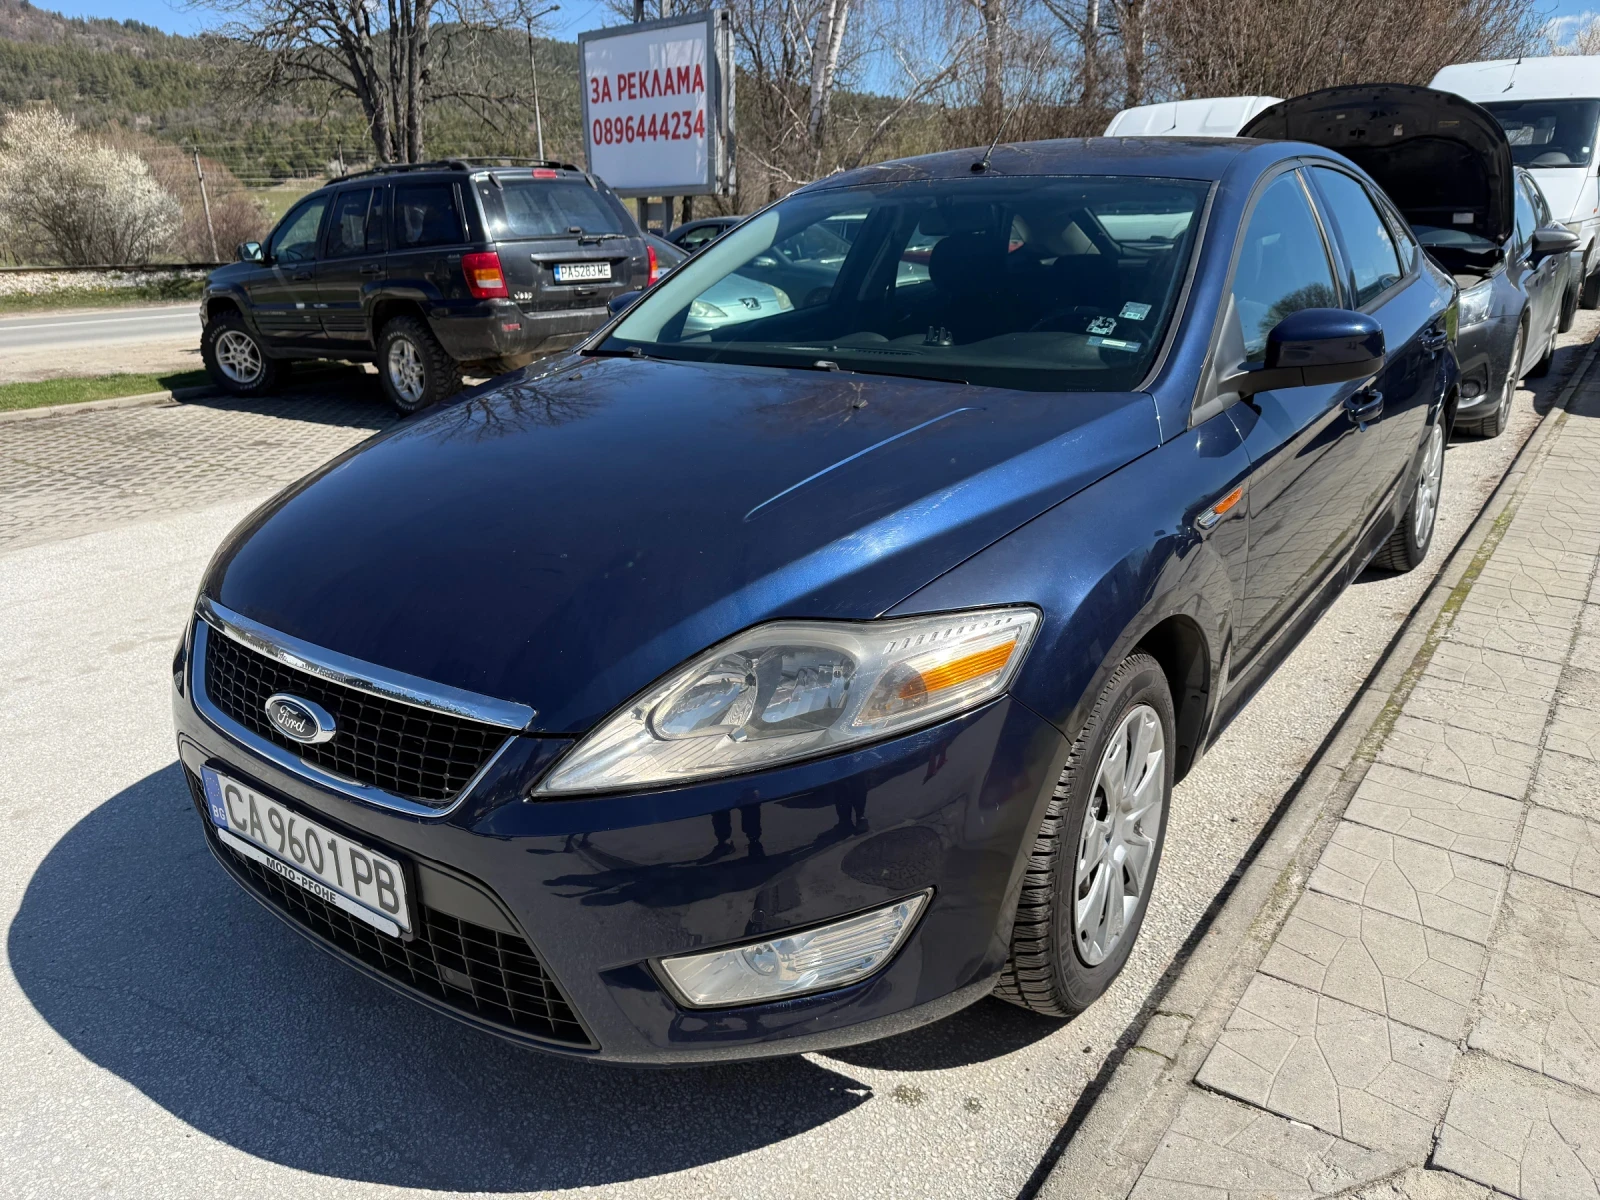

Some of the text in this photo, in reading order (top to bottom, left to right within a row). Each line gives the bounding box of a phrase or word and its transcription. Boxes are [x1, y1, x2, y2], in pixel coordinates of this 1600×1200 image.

[590, 63, 705, 104] ЗА РЕКЛАМА
[592, 109, 705, 146] 0896444234
[277, 705, 305, 734] Ford
[213, 804, 226, 821] BG
